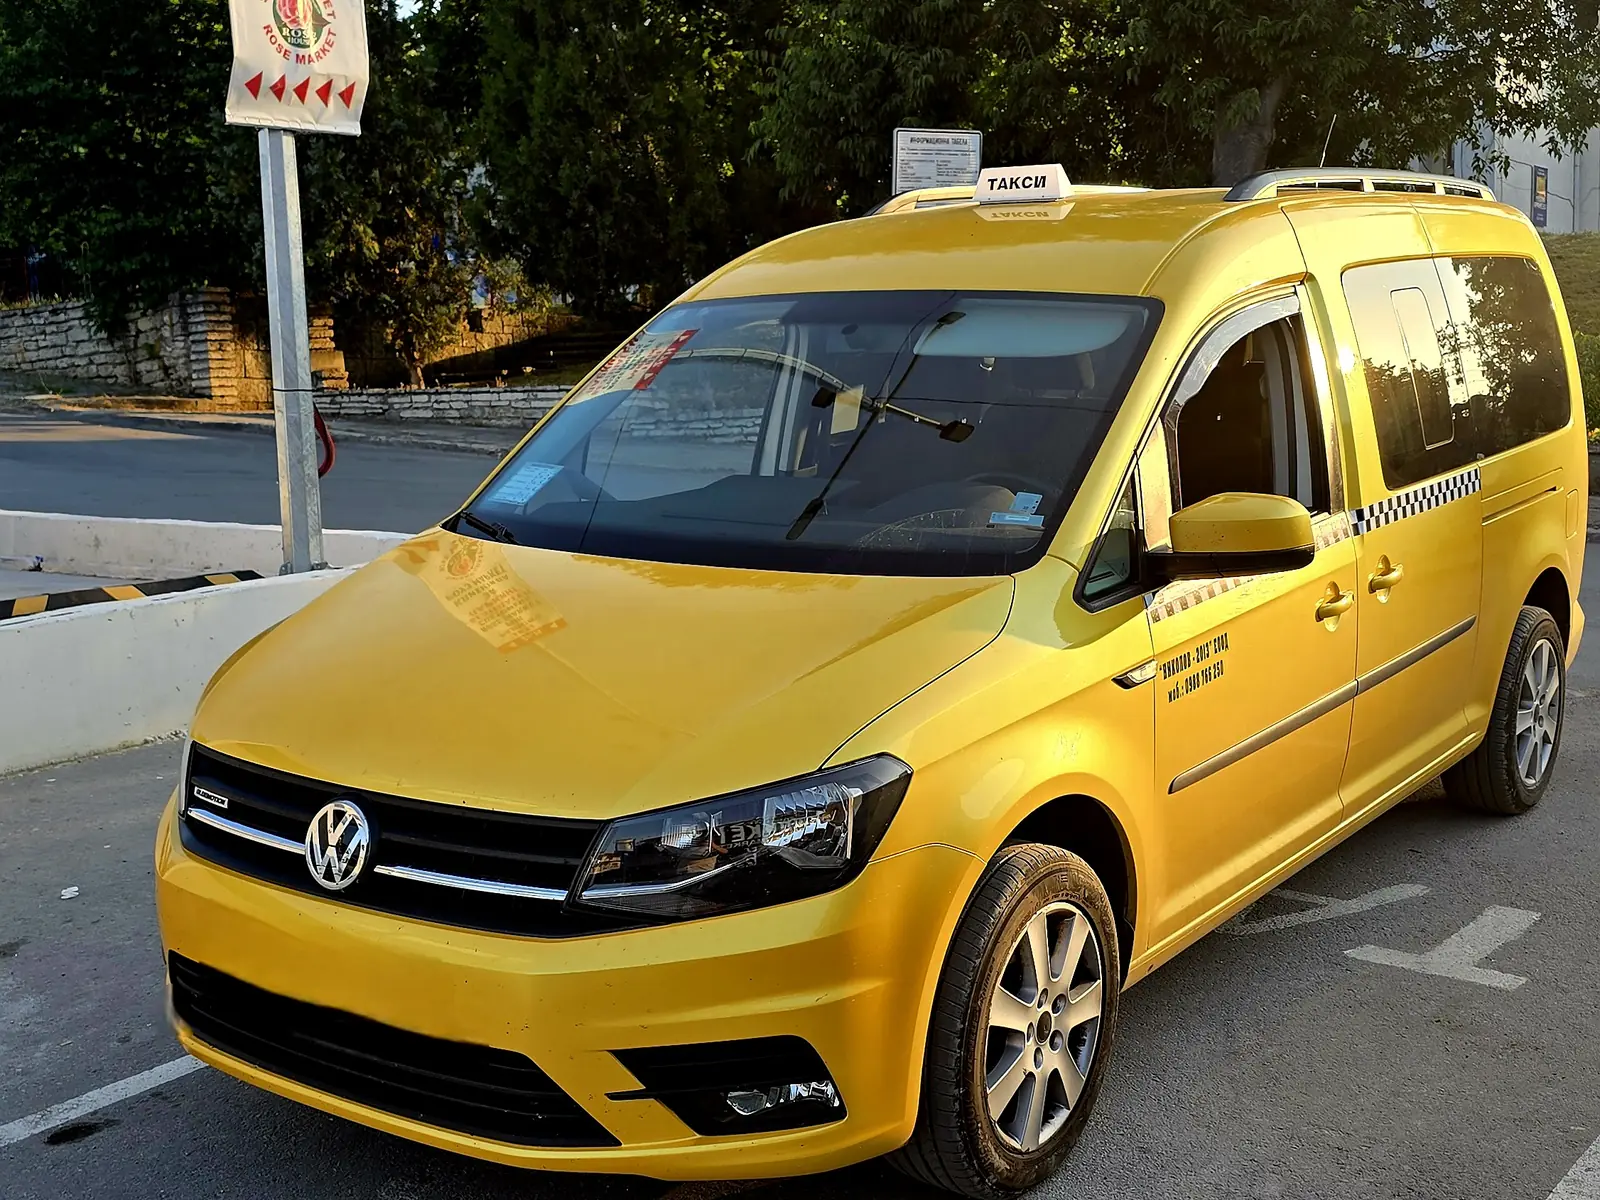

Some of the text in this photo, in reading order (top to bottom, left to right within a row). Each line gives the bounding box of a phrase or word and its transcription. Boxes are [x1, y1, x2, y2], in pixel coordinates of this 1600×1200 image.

[263, 24, 337, 65] ROSE MARKET
[987, 175, 1047, 191] ТАКСИ
